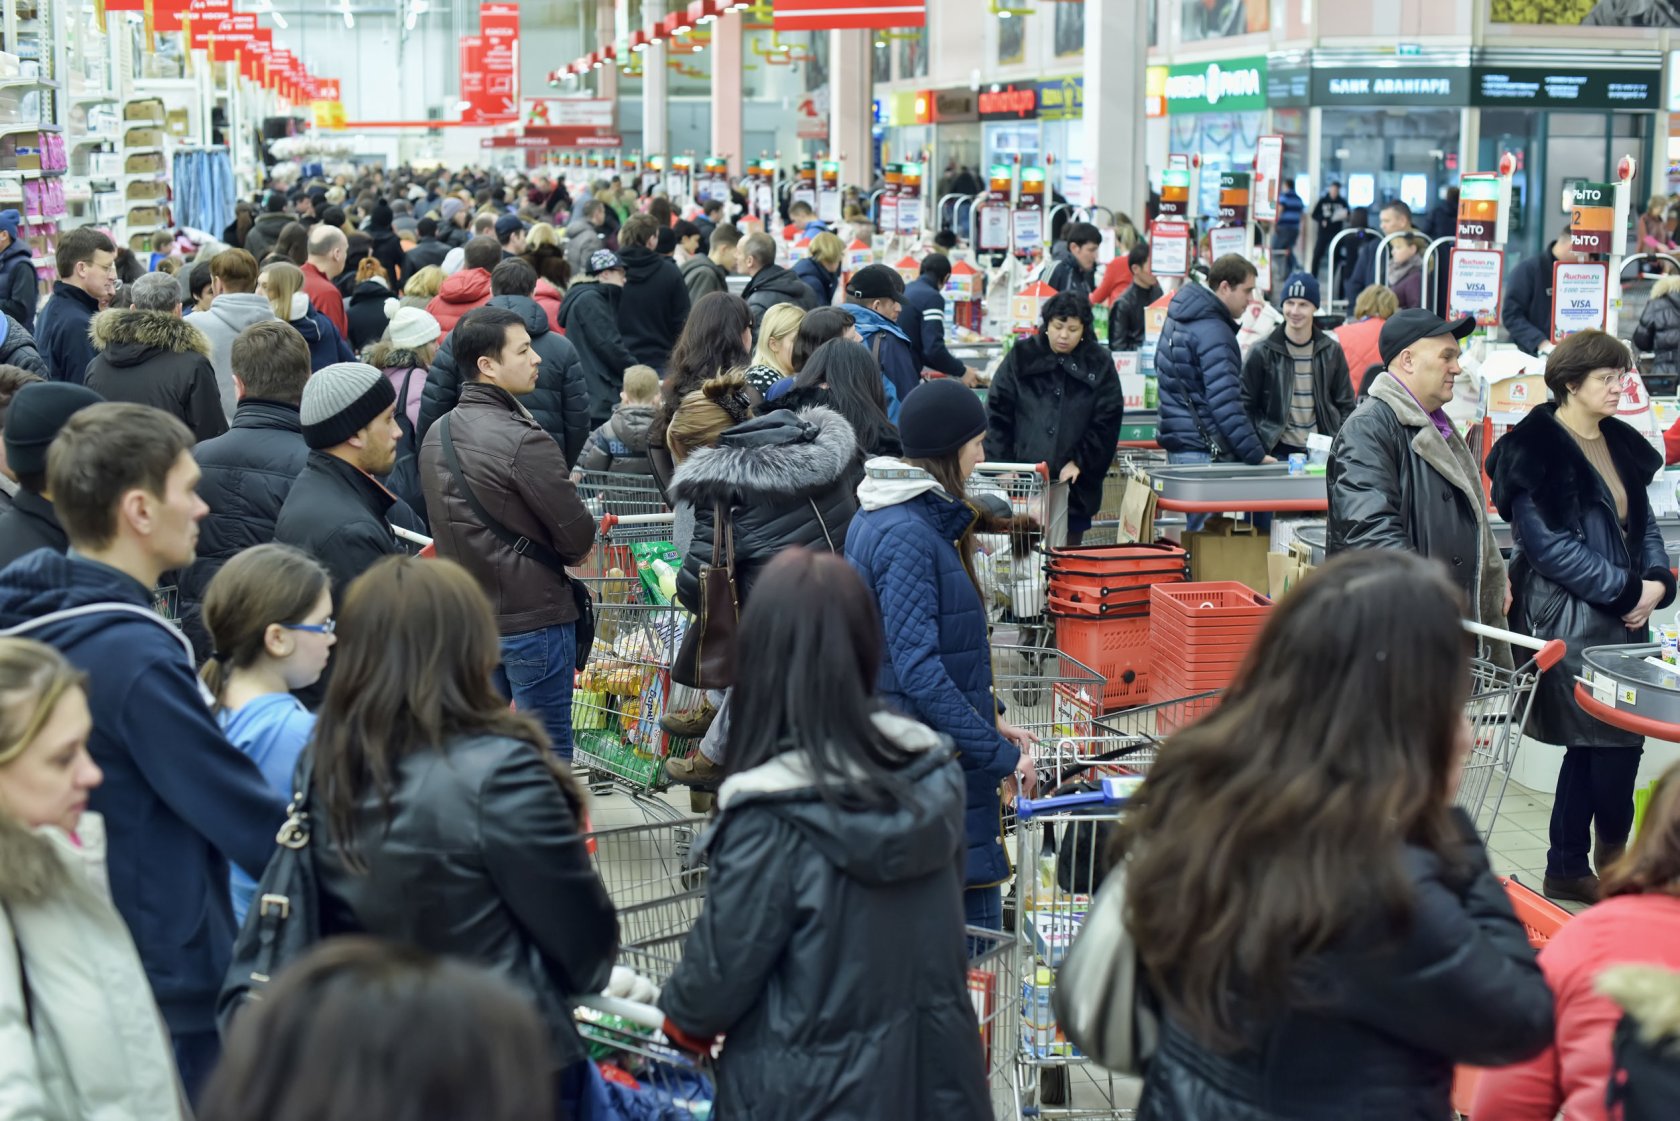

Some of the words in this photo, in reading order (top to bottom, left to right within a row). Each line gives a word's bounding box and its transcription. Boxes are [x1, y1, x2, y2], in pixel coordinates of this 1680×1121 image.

[1328, 78, 1369, 95] БАНК
[1373, 78, 1450, 96] АВАНГАРД
[1563, 271, 1599, 280] Auchan.ru
[1466, 282, 1486, 291] VISA
[1570, 299, 1591, 308] VISA
